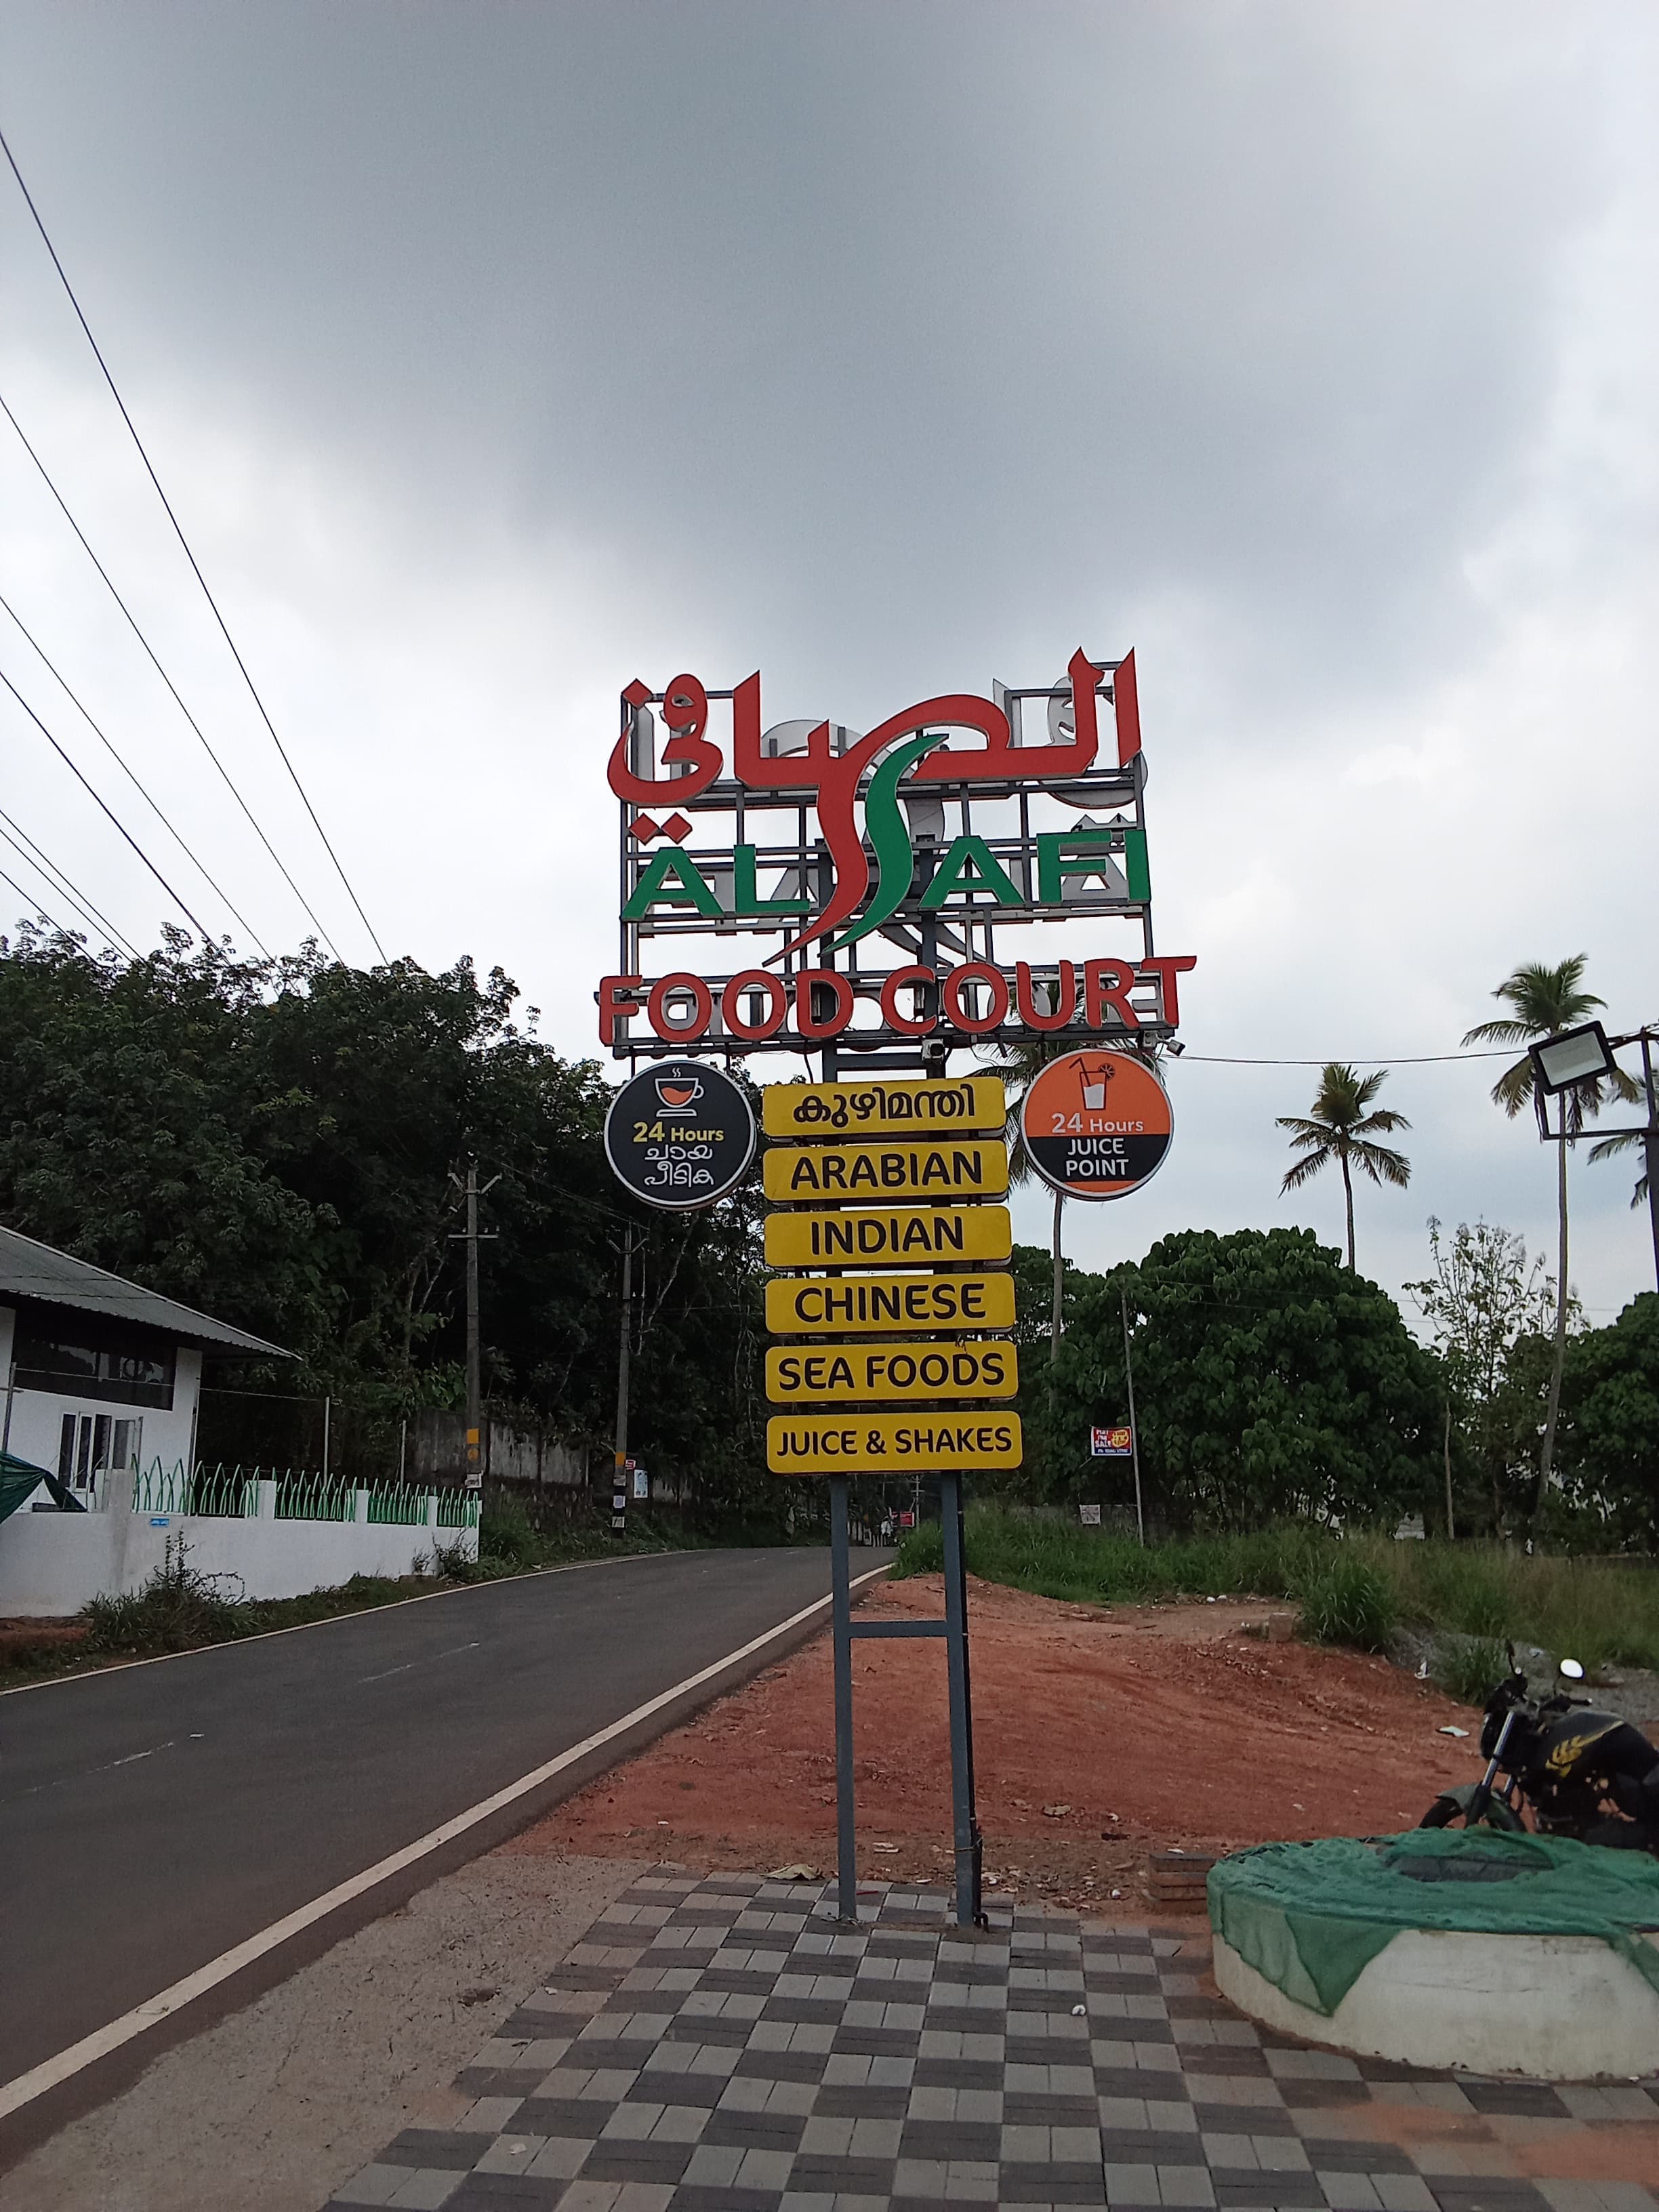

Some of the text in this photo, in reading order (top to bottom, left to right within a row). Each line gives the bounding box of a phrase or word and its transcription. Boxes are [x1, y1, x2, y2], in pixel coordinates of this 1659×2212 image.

[598, 956, 1197, 1045] FOOD COURT
[794, 1083, 975, 1128] കുഴിമന്തി
[633, 1122, 724, 1143] 24 Hours
[1051, 1112, 1144, 1134] 24 Hours
[644, 1144, 712, 1160] ചായ
[1067, 1138, 1125, 1155] JUICE
[644, 1161, 714, 1187] പീടിക
[790, 1151, 982, 1191] ARABIAN
[1065, 1159, 1129, 1176] POINT
[811, 1216, 964, 1255] INDIAN
[794, 1283, 987, 1323] CHINESE
[778, 1352, 1005, 1391] SEA FOODS
[777, 1427, 1012, 1457] JUICE & SHAKES
